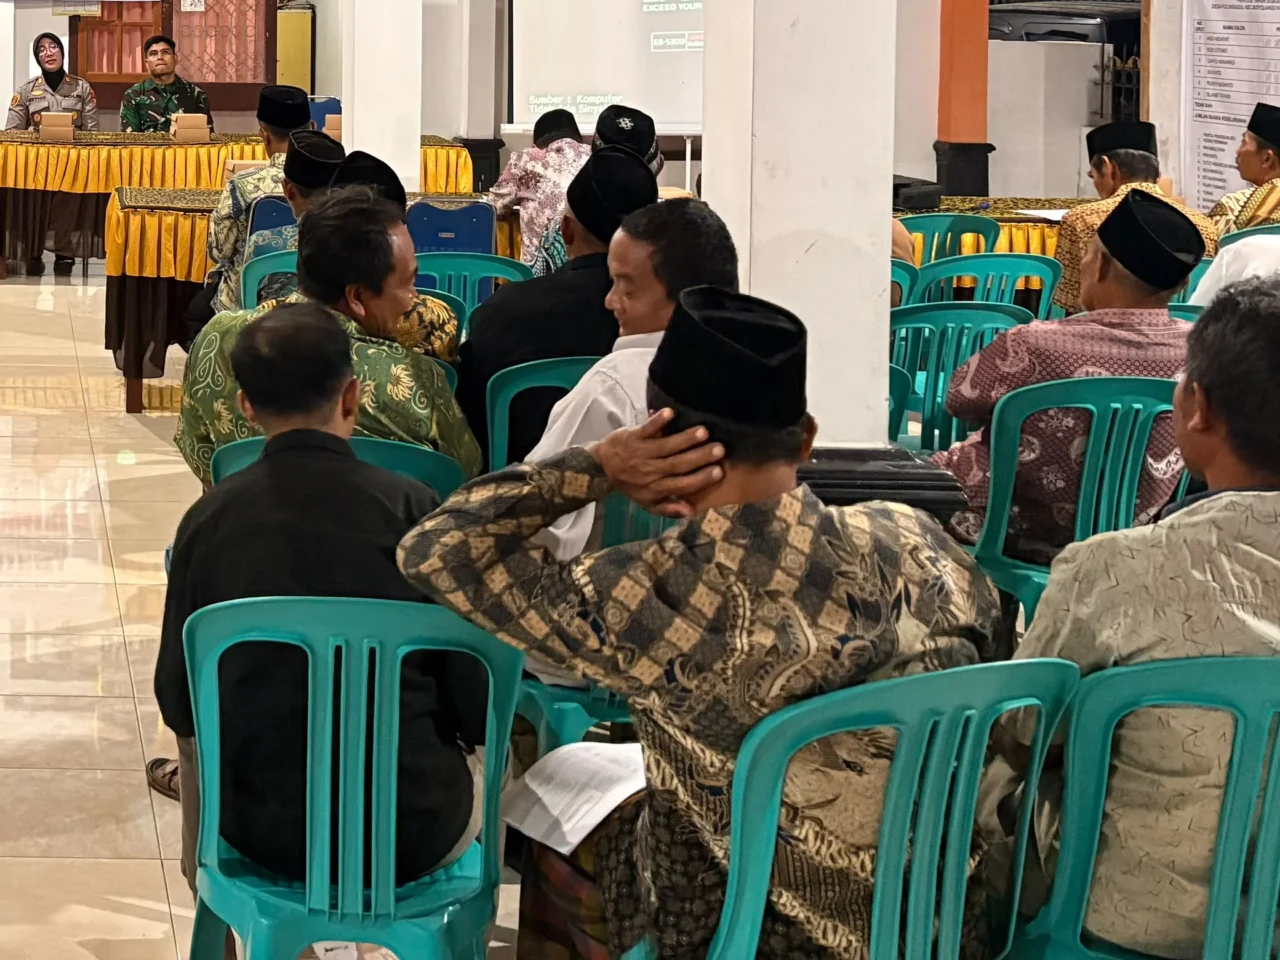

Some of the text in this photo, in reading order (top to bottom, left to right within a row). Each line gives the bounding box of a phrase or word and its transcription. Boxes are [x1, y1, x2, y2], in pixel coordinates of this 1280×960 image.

[643, 3, 677, 12] EXCEED
[529, 95, 563, 104] Sumber
[577, 94, 623, 105] Komputer
